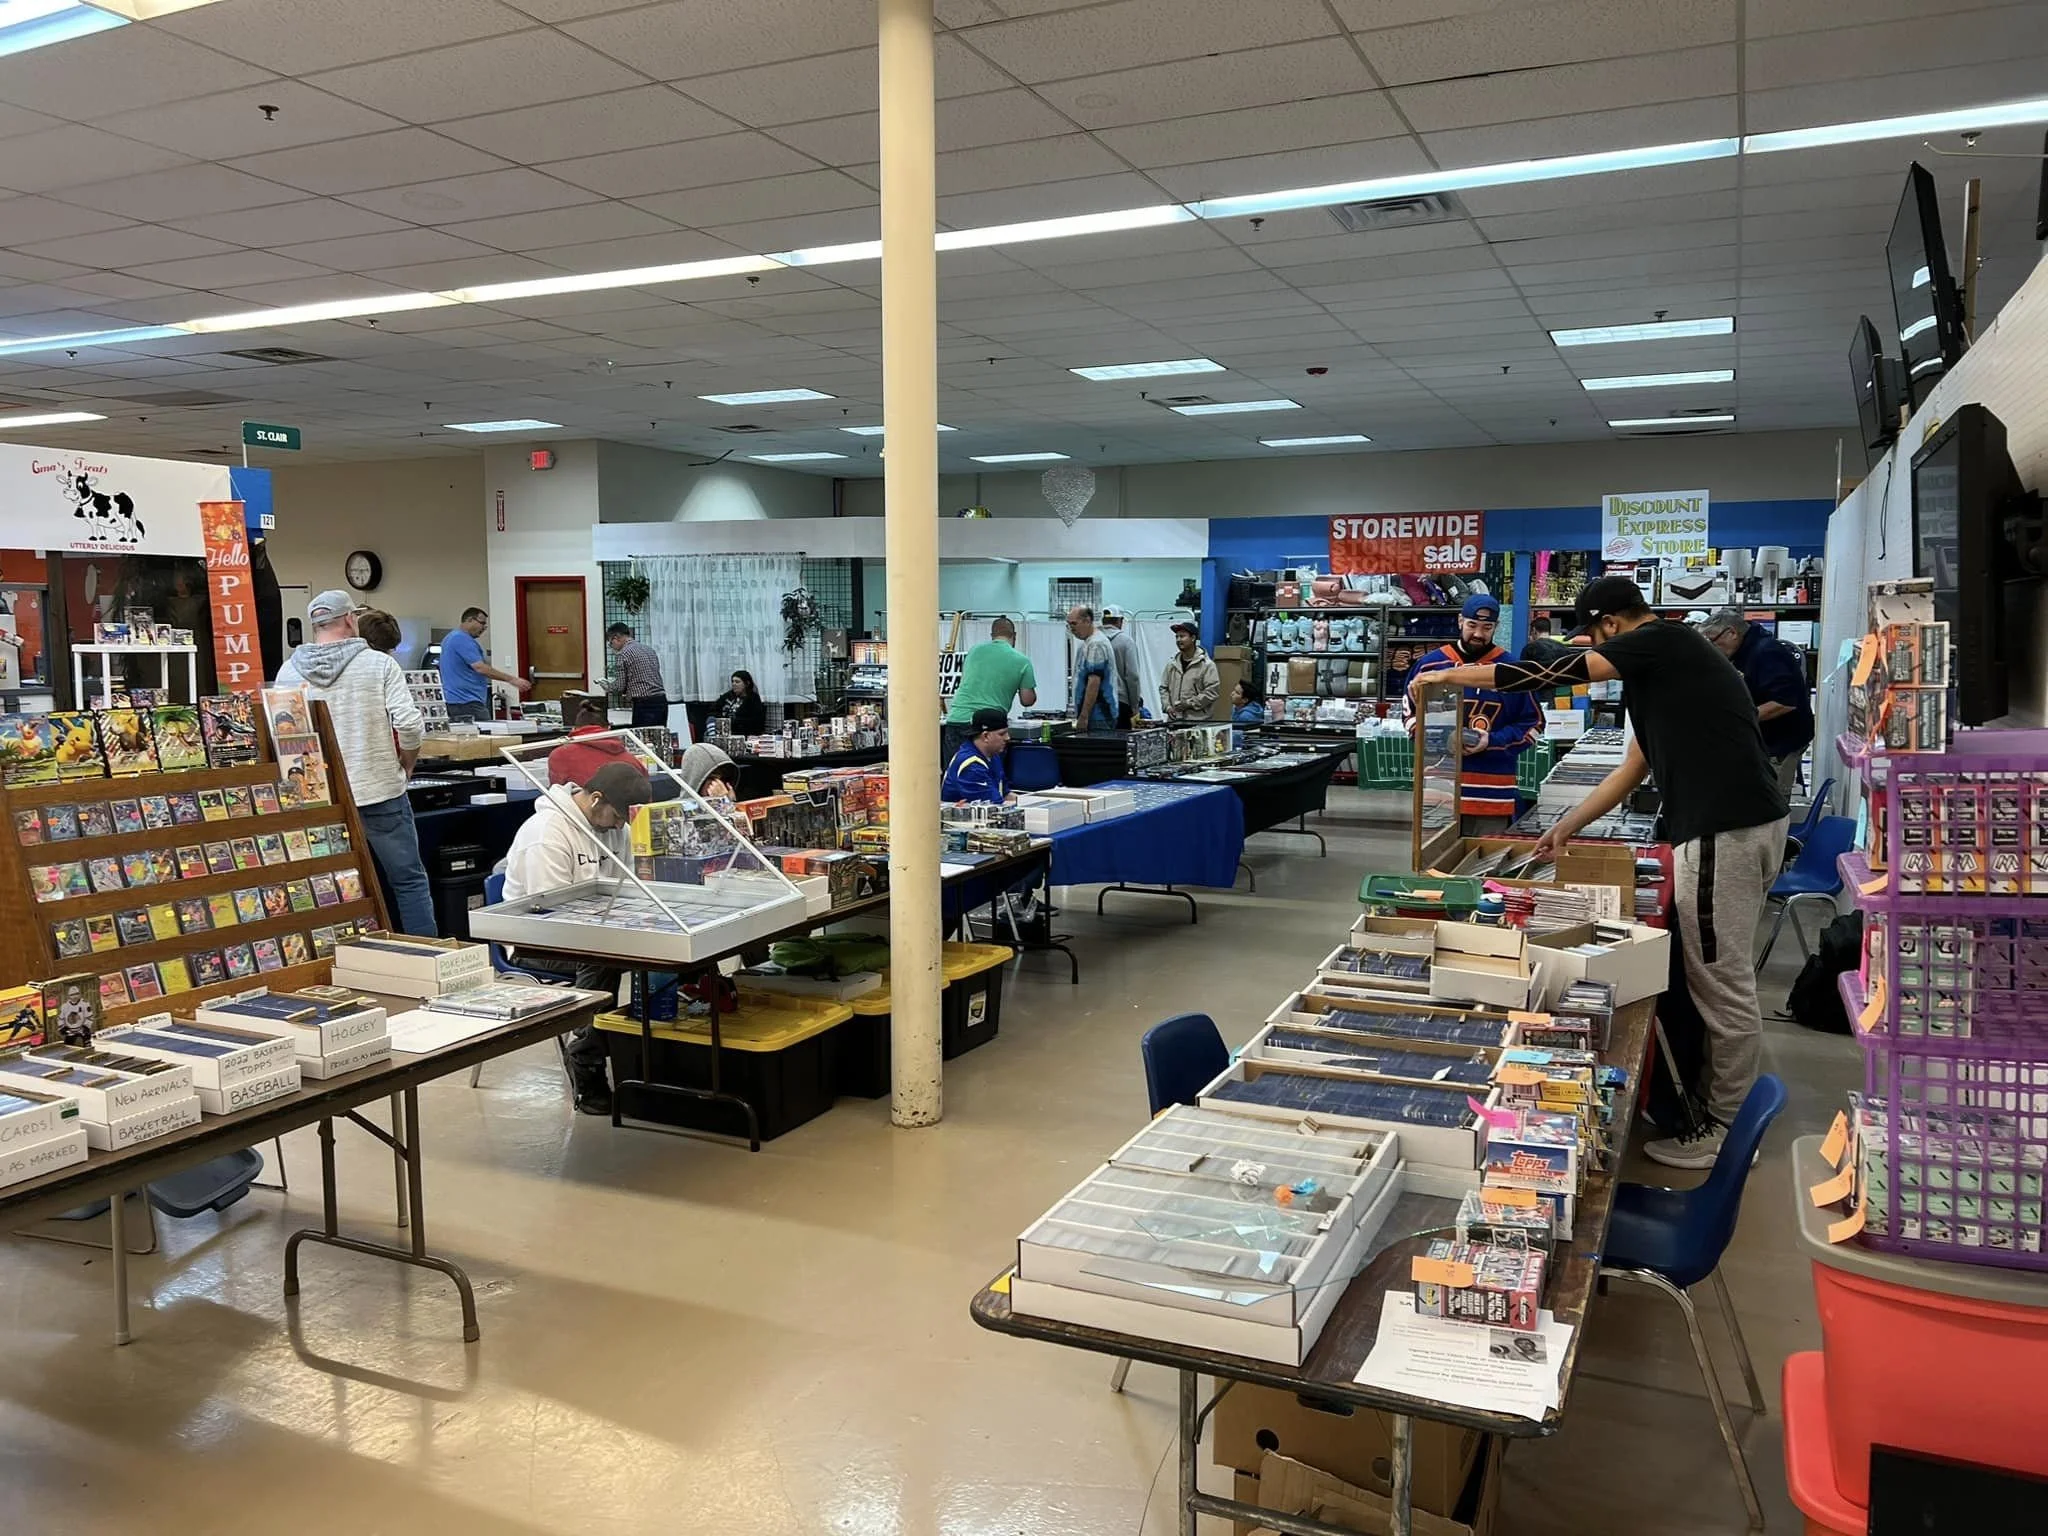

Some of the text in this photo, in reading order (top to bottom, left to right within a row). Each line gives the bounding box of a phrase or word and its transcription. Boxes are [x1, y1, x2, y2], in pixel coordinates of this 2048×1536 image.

[269, 431, 288, 443] CLAIR
[1608, 497, 1703, 517] DISCOUNT
[263, 516, 274, 526] 121
[1332, 514, 1479, 540] STOREWIDE
[1617, 517, 1707, 536] EXPRESS
[70, 542, 135, 551] UTTERLY DELICIOUS
[206, 542, 249, 568] Hello
[1423, 538, 1477, 563] sale
[1641, 537, 1705, 555] STORE
[219, 575, 255, 697] PUMP
[330, 1019, 377, 1043] HOCKEY
[224, 1041, 295, 1068] 2022 BASEBALL
[239, 1060, 272, 1076] TOPPS
[115, 1077, 191, 1108] NEW ARRIVALS
[230, 1075, 295, 1105] BASEBALL
[1, 1111, 54, 1142] CARDS!
[118, 1110, 191, 1141] BASKETBALL
[31, 1143, 77, 1167] MARKED
